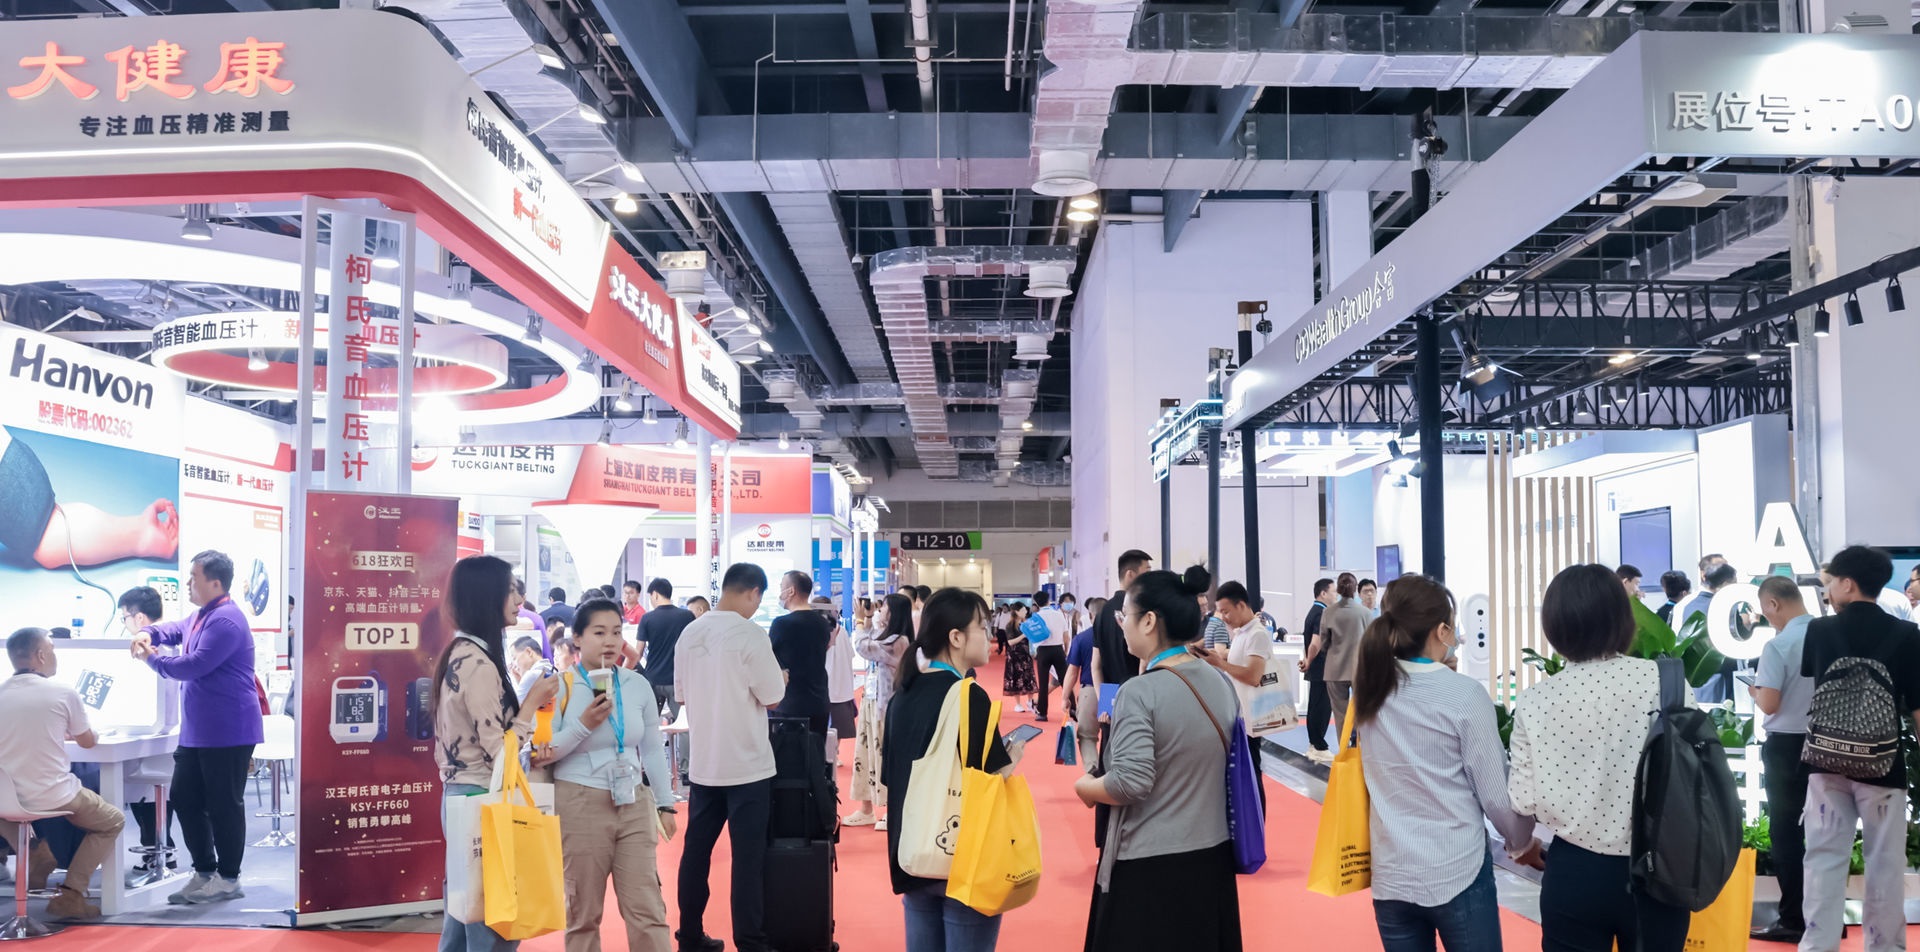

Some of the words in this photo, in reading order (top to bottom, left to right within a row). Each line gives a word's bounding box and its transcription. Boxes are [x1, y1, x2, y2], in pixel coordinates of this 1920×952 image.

[7, 36, 295, 102] 大健康
[1670, 90, 1920, 132] 展位号:TA0
[79, 109, 291, 137] 专注血压精准测量
[608, 265, 675, 349] 汉王大健康
[10, 337, 154, 409] Hanvon
[342, 254, 372, 482] 柯氏音血压计
[451, 459, 513, 472] TUCKGIANT
[516, 462, 555, 474] BELTING
[603, 456, 761, 486] 上海达机皮带有公司
[917, 534, 965, 548] H2-10
[352, 554, 415, 568] 618狂欢日
[323, 586, 441, 599] 京东、天猫、抖音三平台
[345, 602, 420, 614] 高端血压计销量
[353, 627, 394, 645] TOP
[400, 627, 410, 645] 1
[351, 706, 365, 716] 82
[1815, 737, 1852, 753] CHRISTIAN
[1853, 744, 1871, 755] DIOR
[325, 782, 433, 799] 汉王柯氏音电子血压计
[350, 799, 410, 813] KSY-FF660
[347, 813, 412, 829] 销售勇攀高峰
